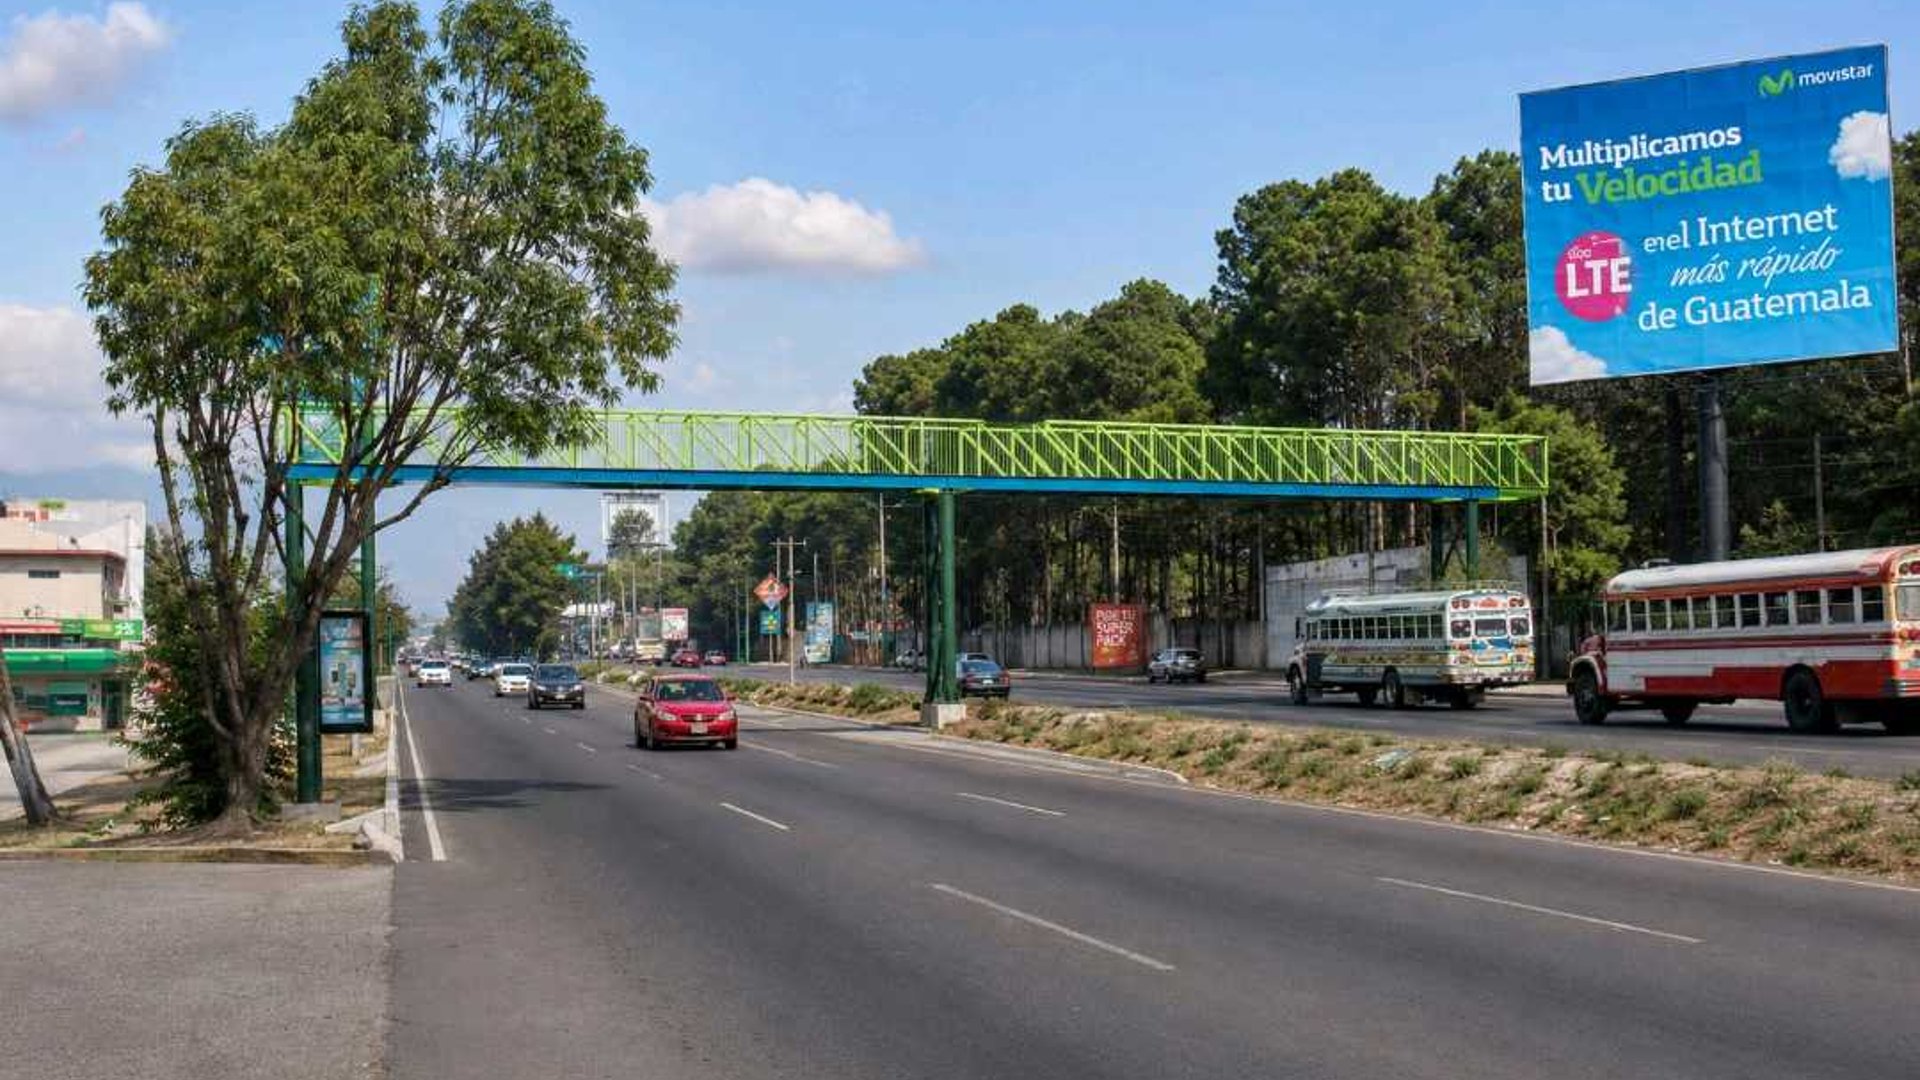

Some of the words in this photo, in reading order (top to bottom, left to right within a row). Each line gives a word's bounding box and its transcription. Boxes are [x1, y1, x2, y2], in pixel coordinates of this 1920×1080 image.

[1798, 64, 1874, 88] movistar
[1539, 126, 1742, 170] Multiplicamos
[1542, 180, 1571, 203] tu
[1576, 150, 1763, 204] Velocidad
[1699, 204, 1839, 248] Internet
[1565, 257, 1632, 299] LTE
[1670, 252, 1728, 287] más
[1738, 236, 1841, 290] rápido
[1639, 301, 1677, 332] de
[1685, 280, 1872, 326] Guatemala
